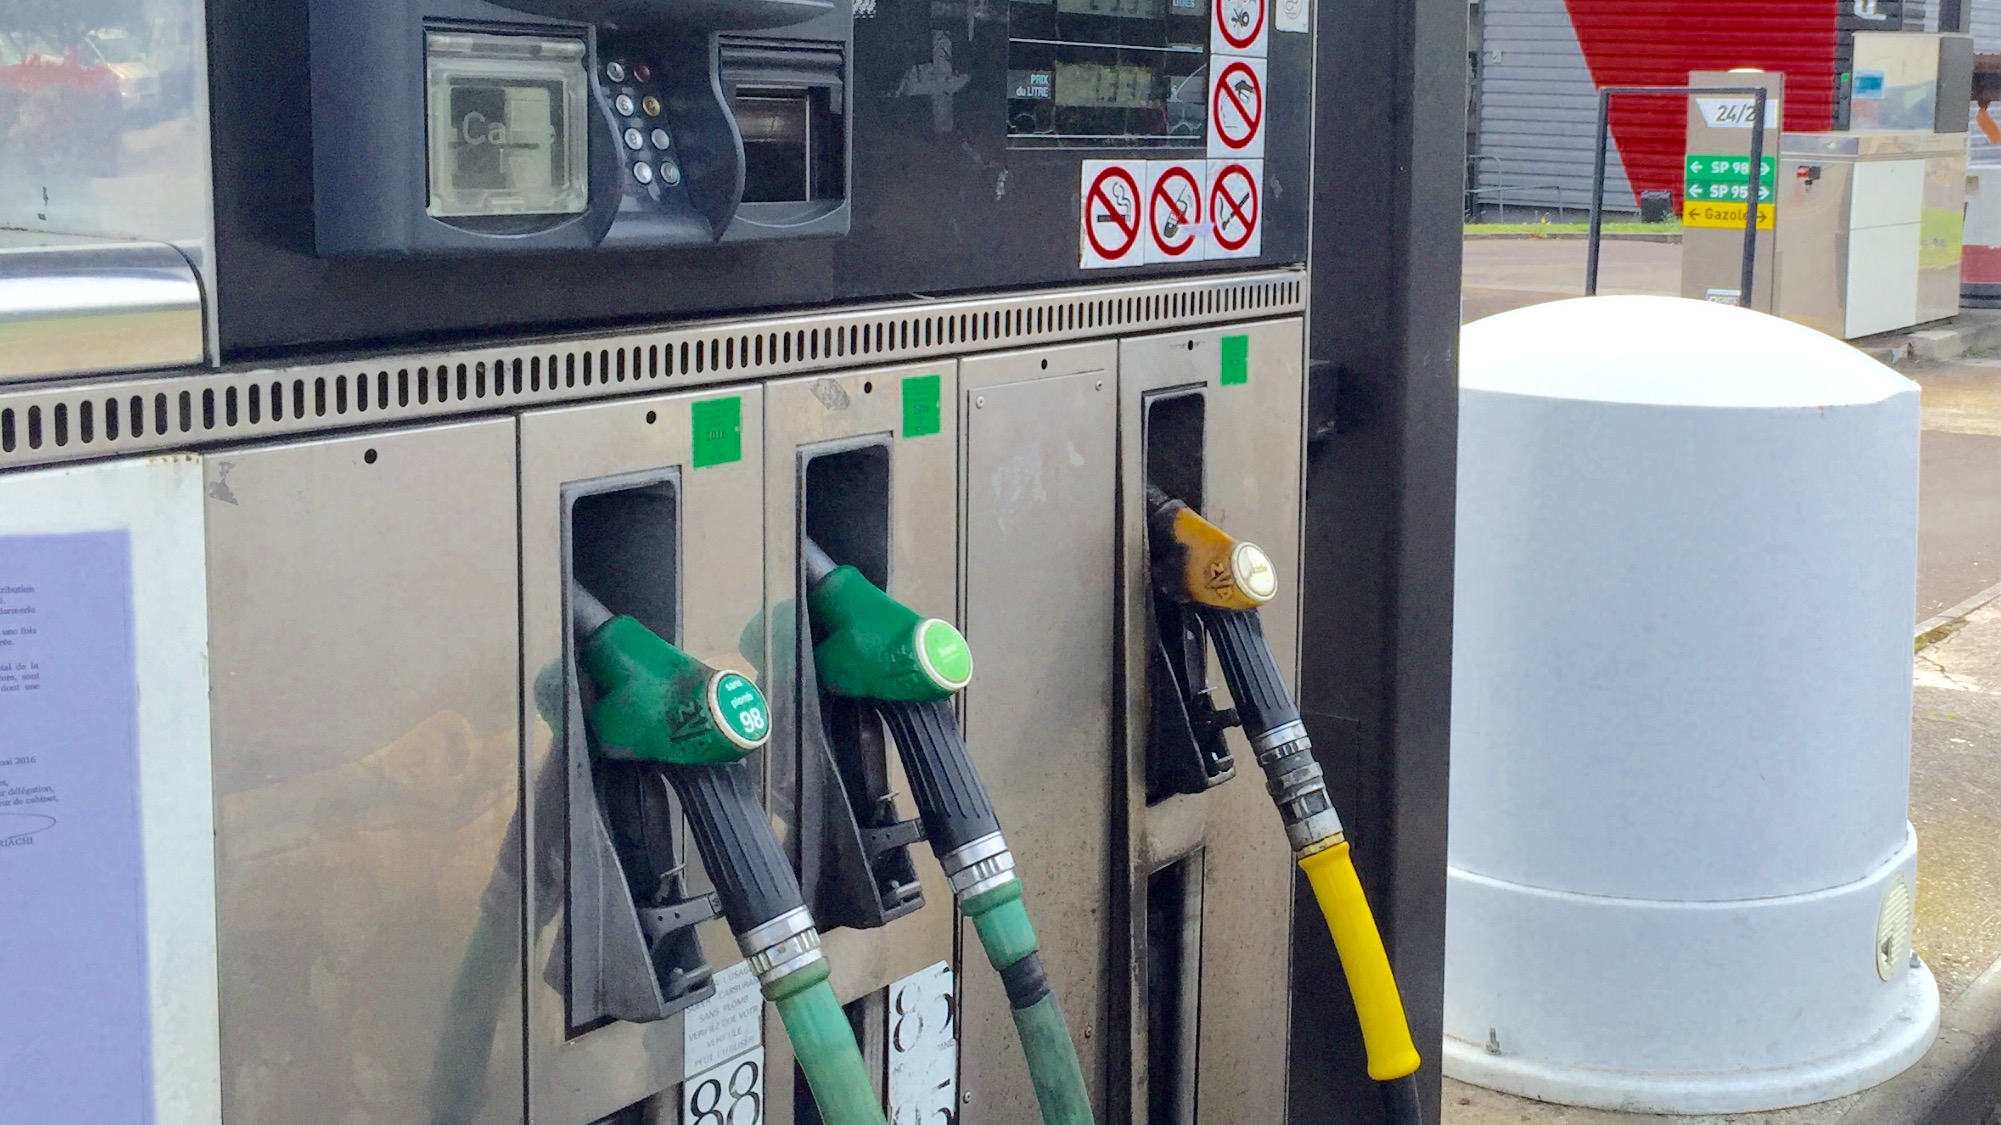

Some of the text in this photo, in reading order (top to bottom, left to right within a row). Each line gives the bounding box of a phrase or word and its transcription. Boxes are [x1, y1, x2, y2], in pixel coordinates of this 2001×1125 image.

[1030, 74, 1049, 85] PRIX
[1016, 86, 1048, 97] du LITRE
[1715, 103, 1757, 124] 24/2
[1711, 161, 1750, 175] SP 98
[1709, 184, 1749, 199] SP 95
[0, 585, 35, 594] ribution
[15, 662, 27, 671] de
[30, 661, 39, 670] la
[739, 707, 765, 733] 98
[15, 755, 37, 765] 2016
[13, 797, 24, 806] de
[699, 1009, 720, 1023] SANS
[738, 1004, 759, 1021] VOTR
